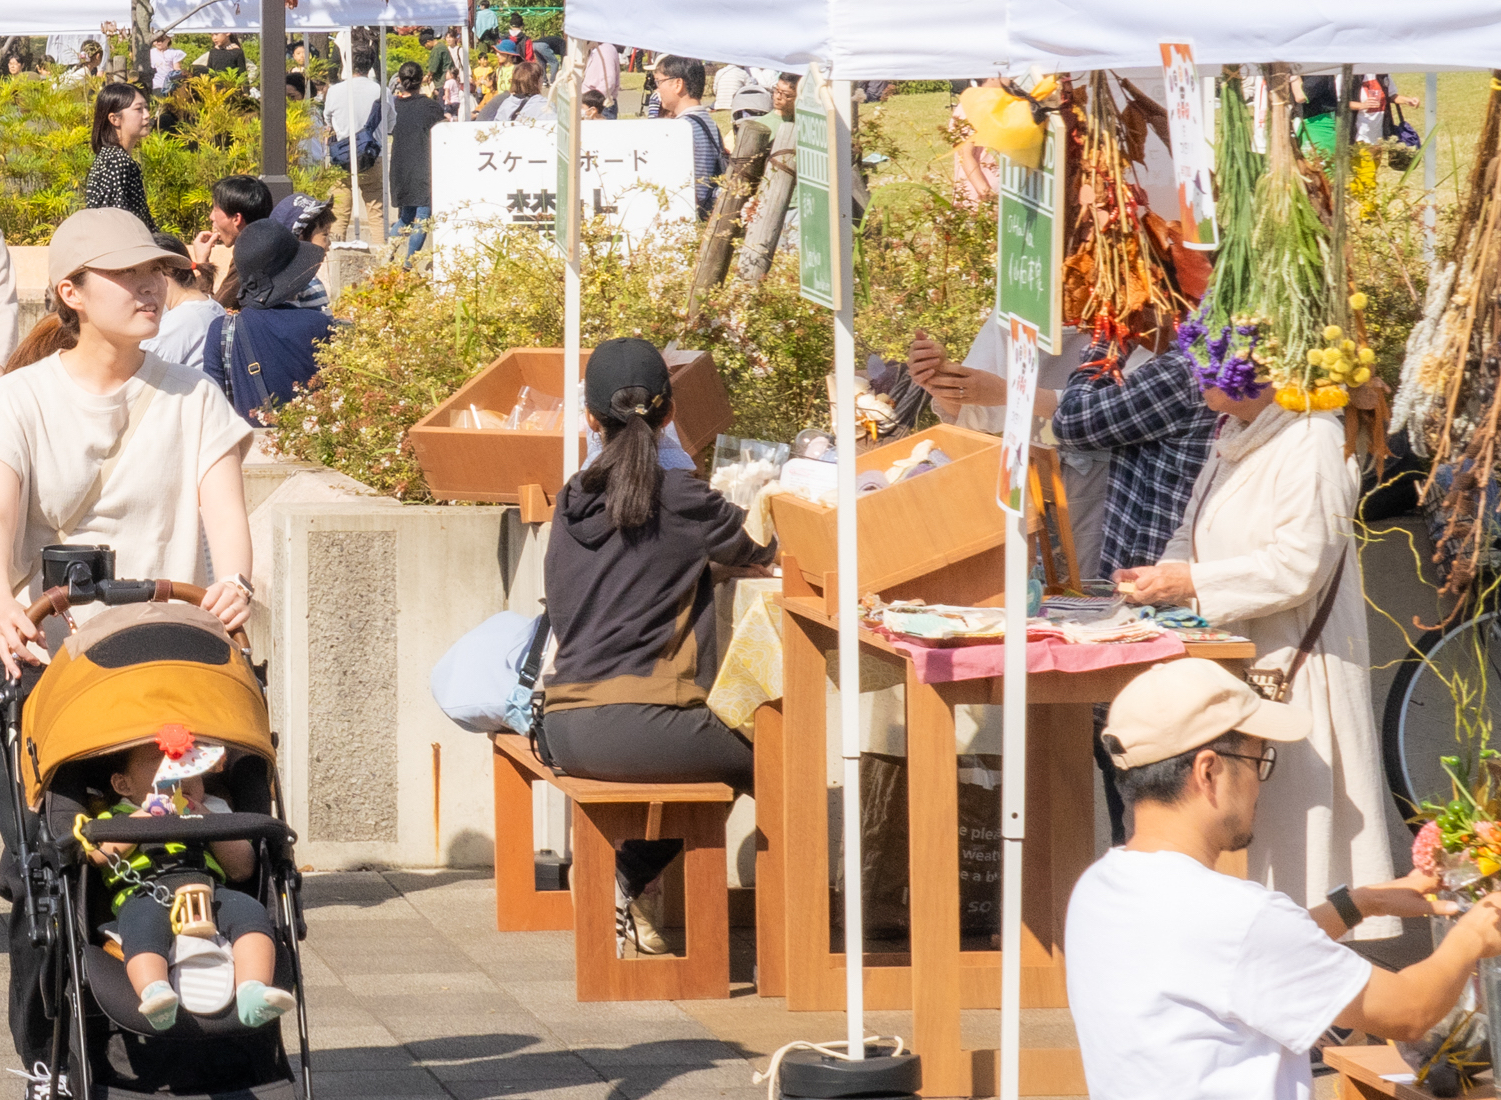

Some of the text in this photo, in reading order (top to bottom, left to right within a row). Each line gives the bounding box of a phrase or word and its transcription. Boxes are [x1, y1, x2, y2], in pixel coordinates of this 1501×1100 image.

[477, 149, 649, 173] スケーボード
[971, 827, 1001, 840] plea
